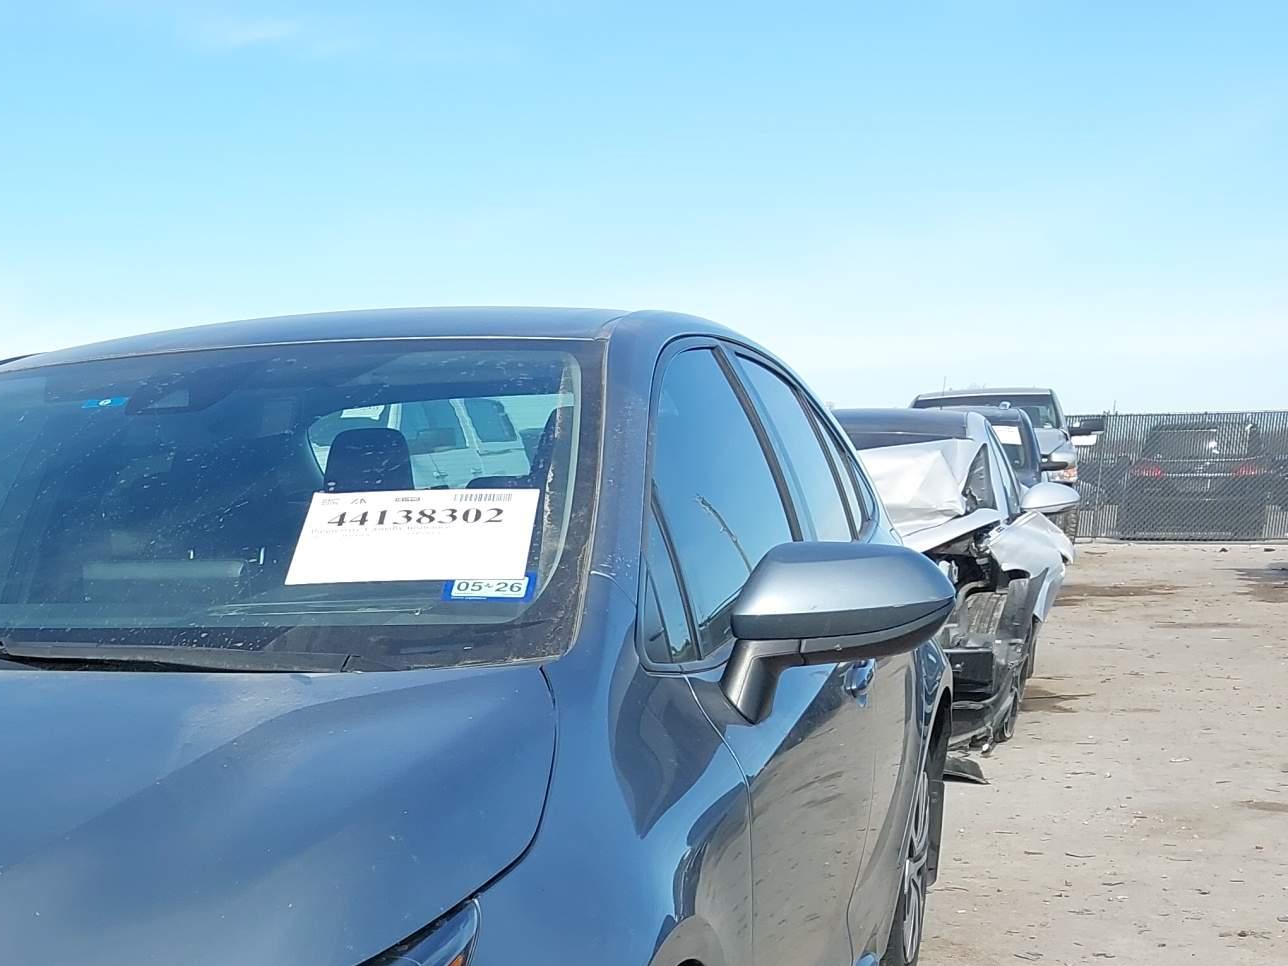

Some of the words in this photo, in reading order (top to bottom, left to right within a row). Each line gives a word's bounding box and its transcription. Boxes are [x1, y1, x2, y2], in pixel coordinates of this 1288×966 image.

[327, 507, 504, 527] 44138302
[456, 581, 484, 592] 05
[494, 582, 523, 593] 26
